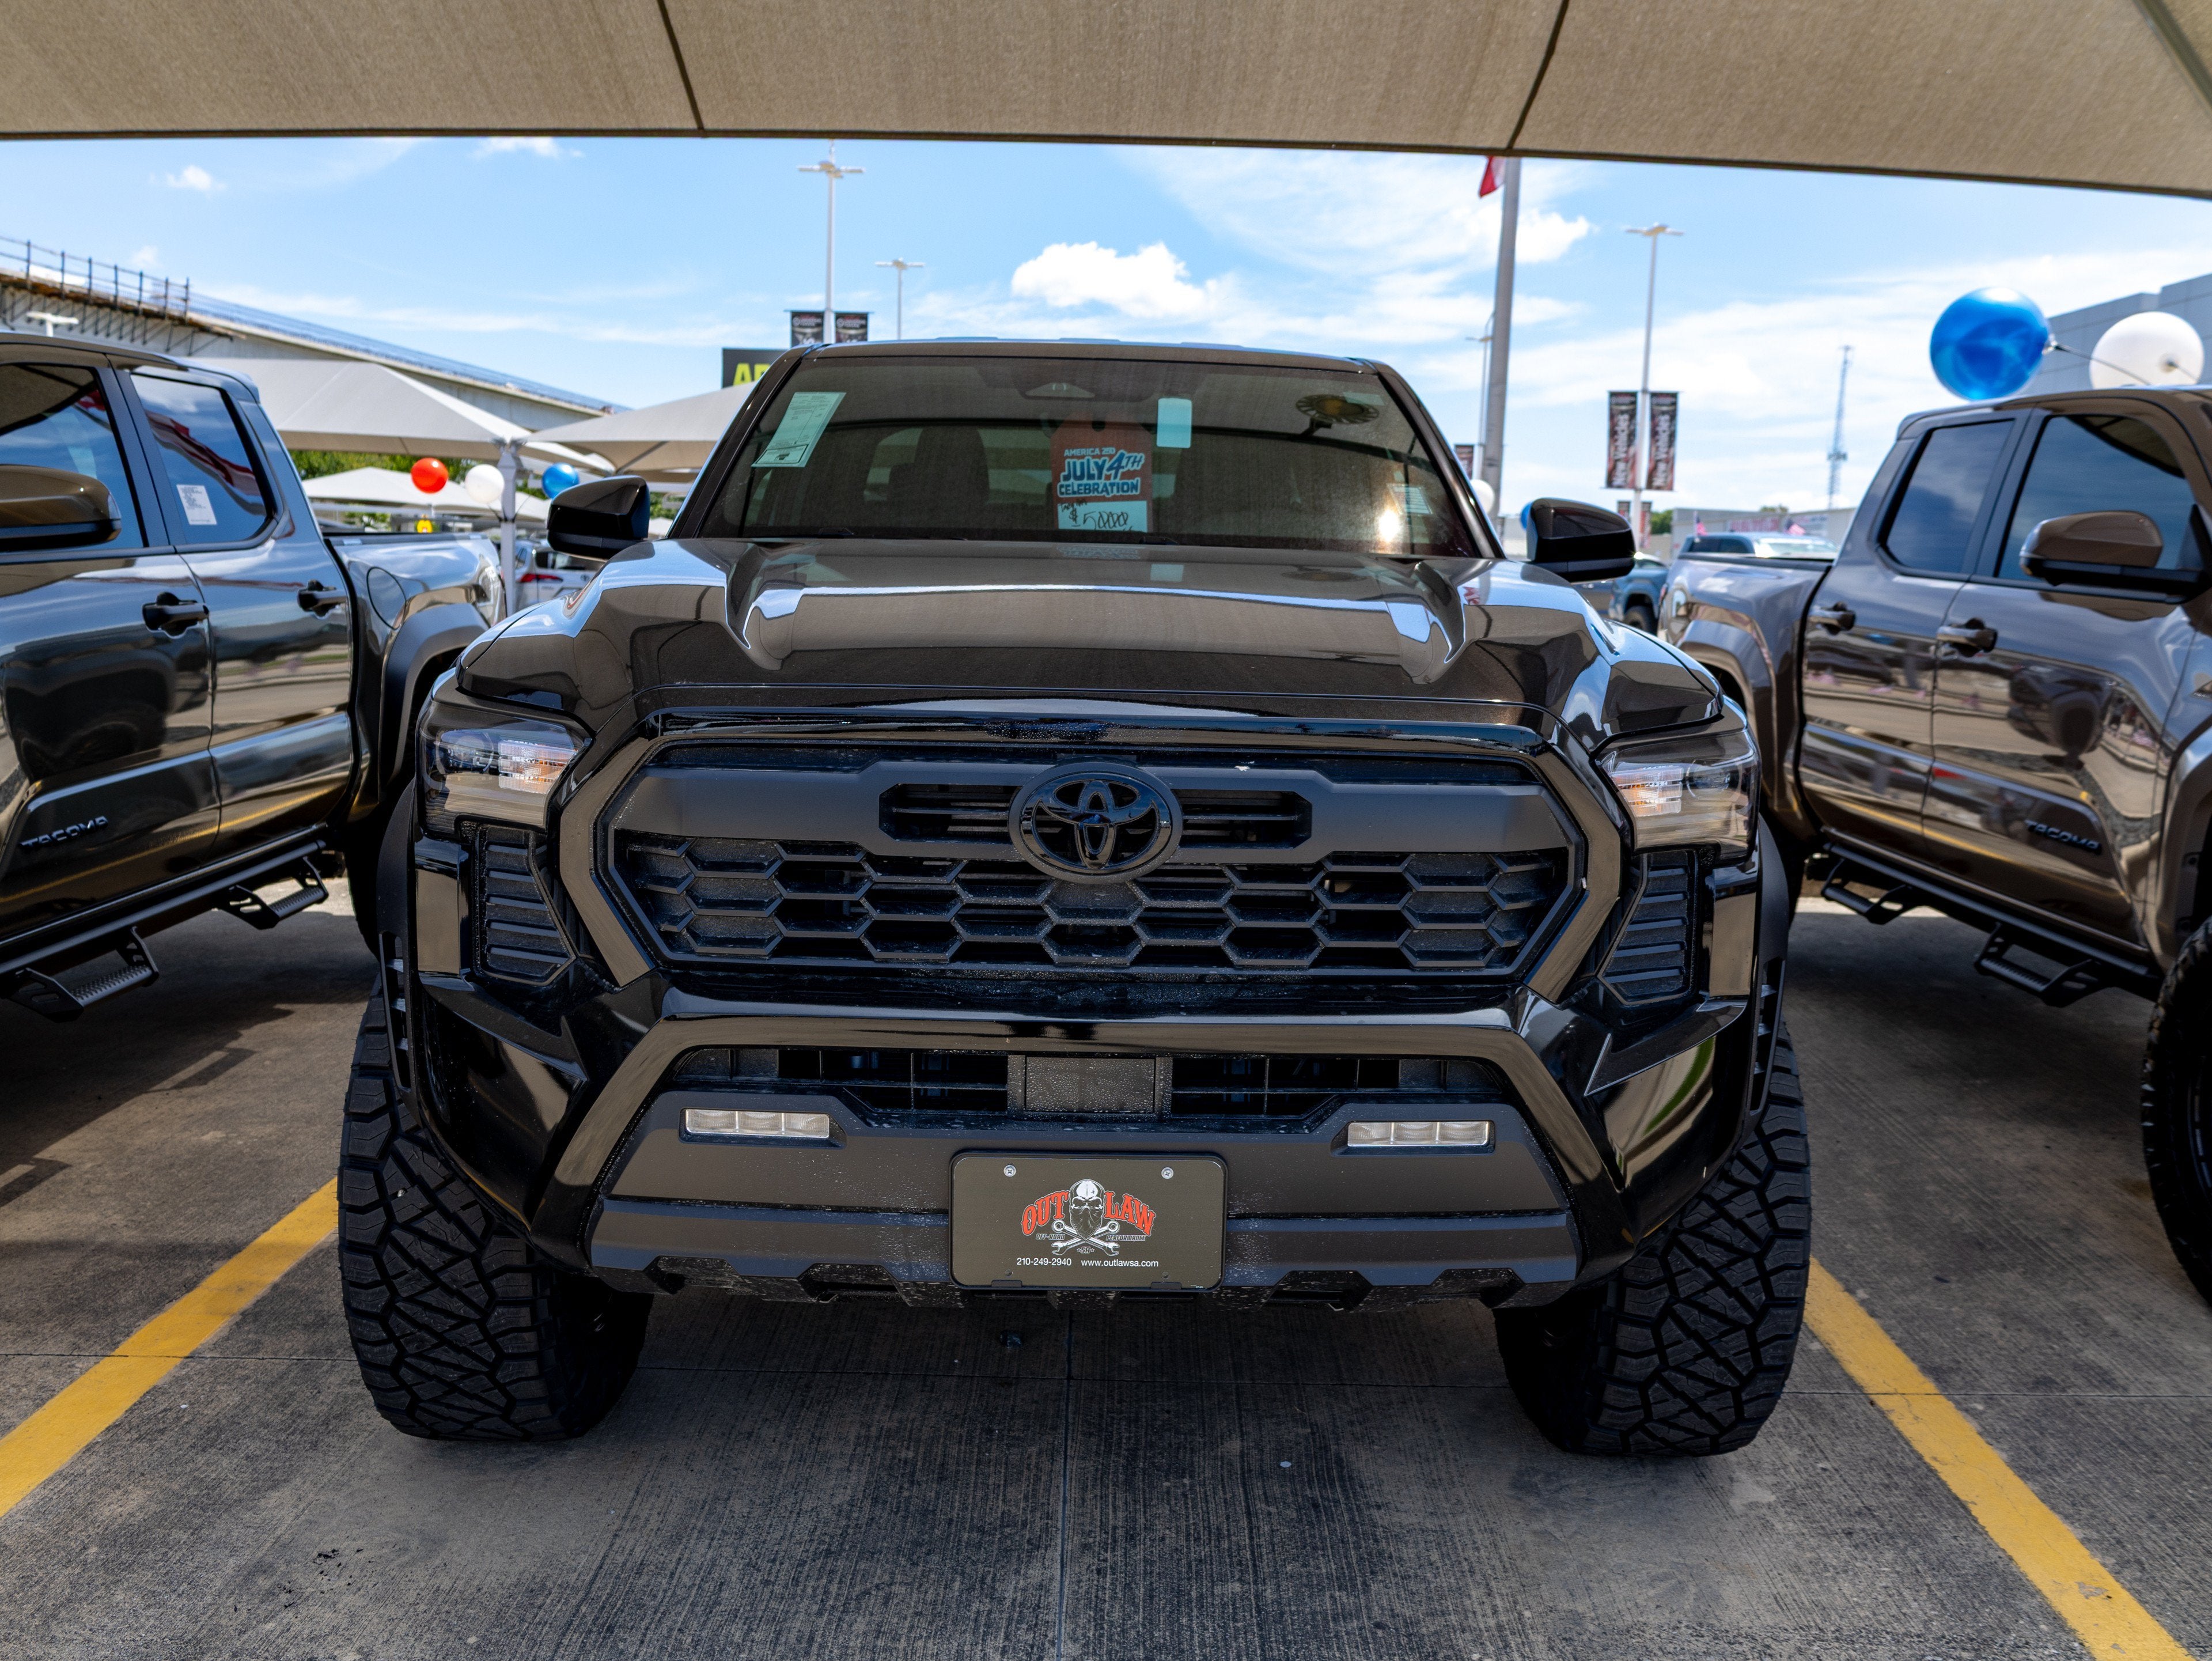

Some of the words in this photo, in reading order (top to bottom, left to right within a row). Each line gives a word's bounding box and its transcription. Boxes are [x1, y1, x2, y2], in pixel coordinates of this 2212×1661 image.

[1064, 448, 1100, 457] AMERICA
[1062, 457, 1107, 481] JULY
[1106, 451, 1143, 479] 4TH
[1058, 479, 1139, 496] CELEBRATION
[20, 815, 108, 848] TACOMA
[2024, 819, 2100, 850] TACOMA
[1017, 1257, 1072, 1266] 210-249-2940
[1081, 1259, 1159, 1267] www.outlawsa.com
